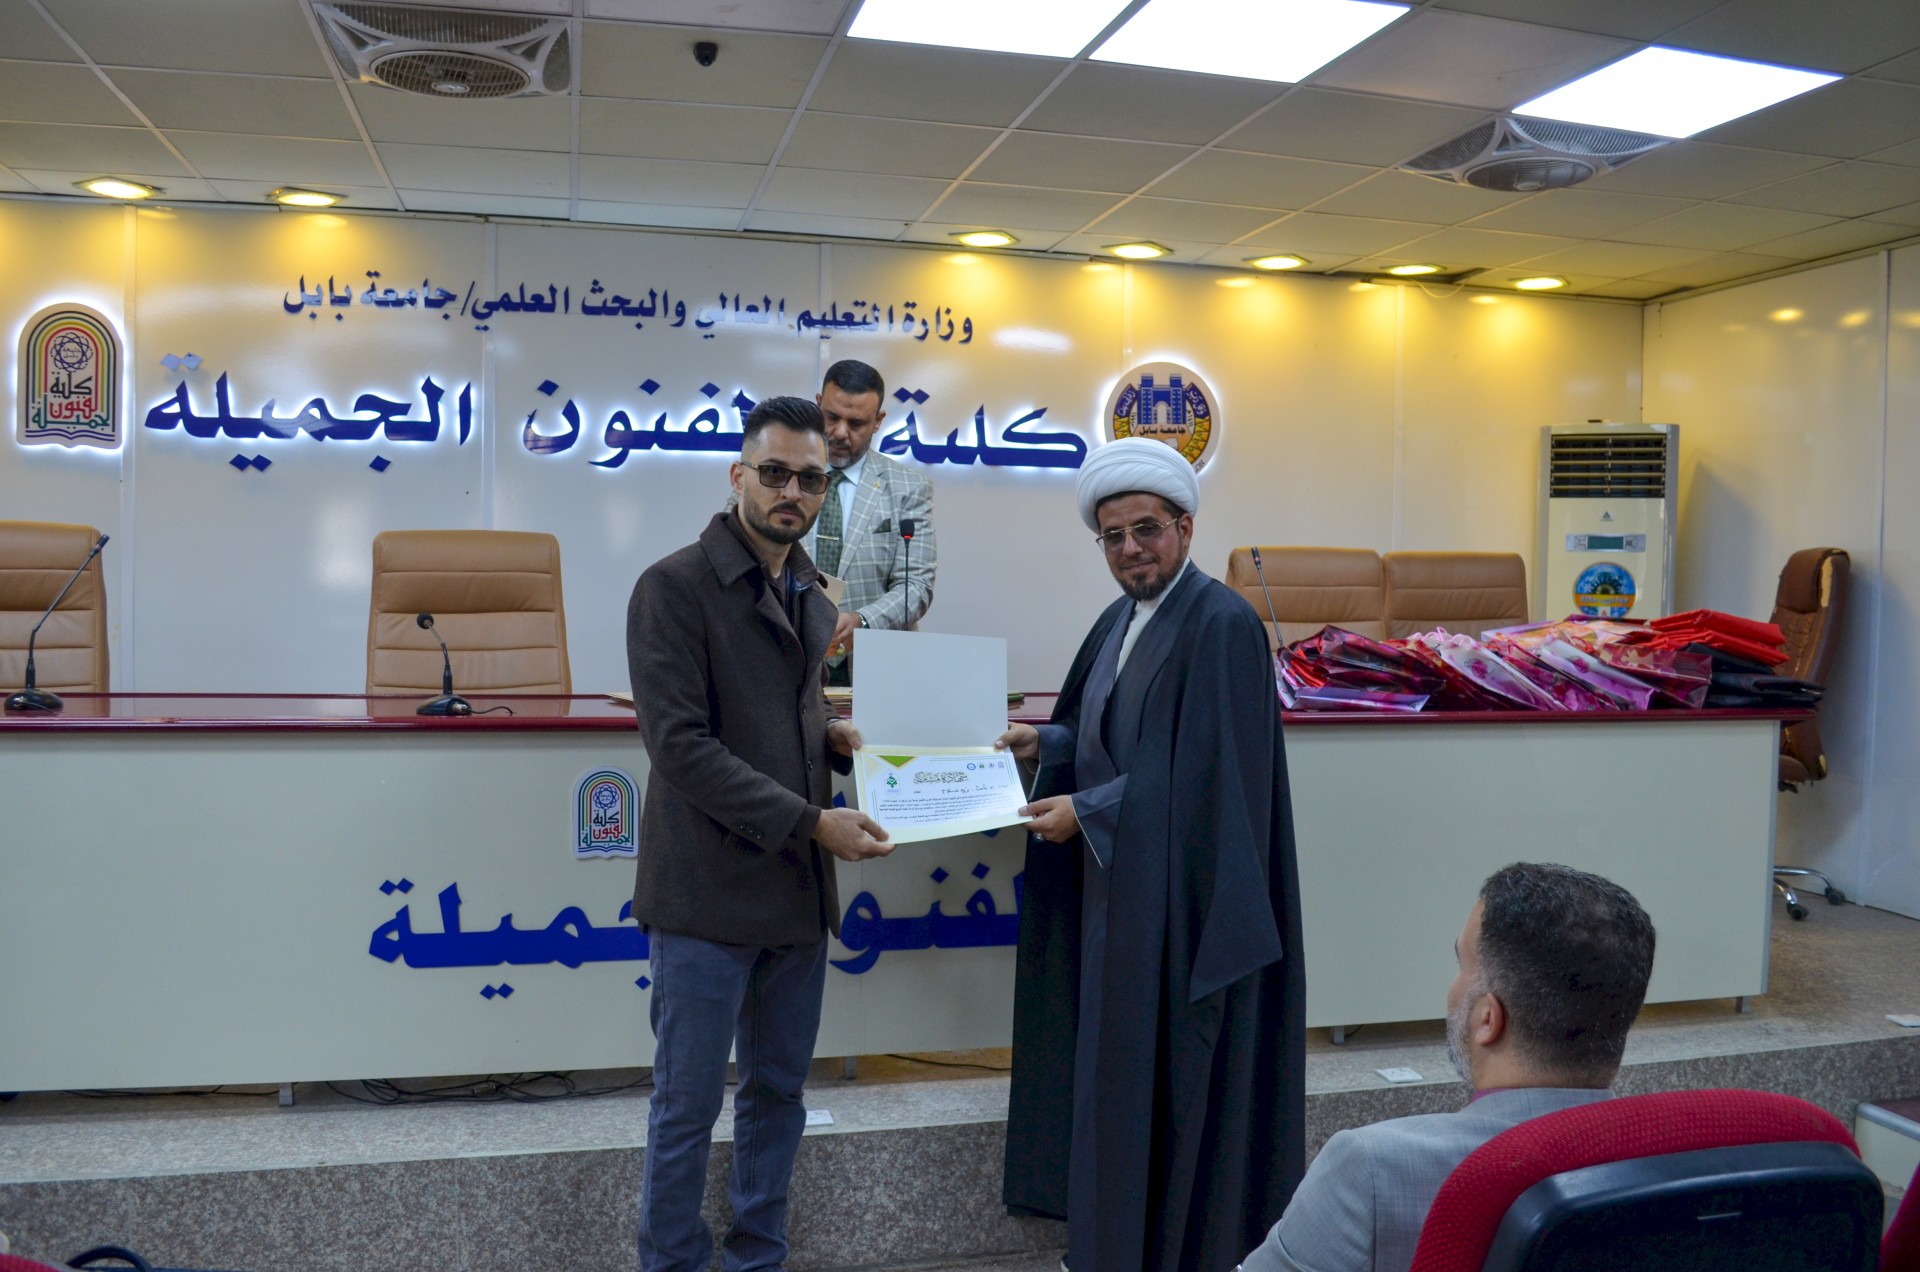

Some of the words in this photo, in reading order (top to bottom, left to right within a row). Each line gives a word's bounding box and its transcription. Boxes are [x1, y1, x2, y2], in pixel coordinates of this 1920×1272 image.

[283, 274, 352, 321] بابل
[581, 278, 687, 330] والبحث
[695, 292, 785, 339] العالي
[797, 300, 894, 340] التعليم
[901, 300, 973, 344] وزارة
[50, 371, 93, 399] كلية
[144, 352, 472, 472] الجميلة
[523, 378, 756, 469] لفنون
[1139, 426, 1157, 435] بابل
[1159, 425, 1186, 434] جامعة
[593, 809, 619, 827] كلية
